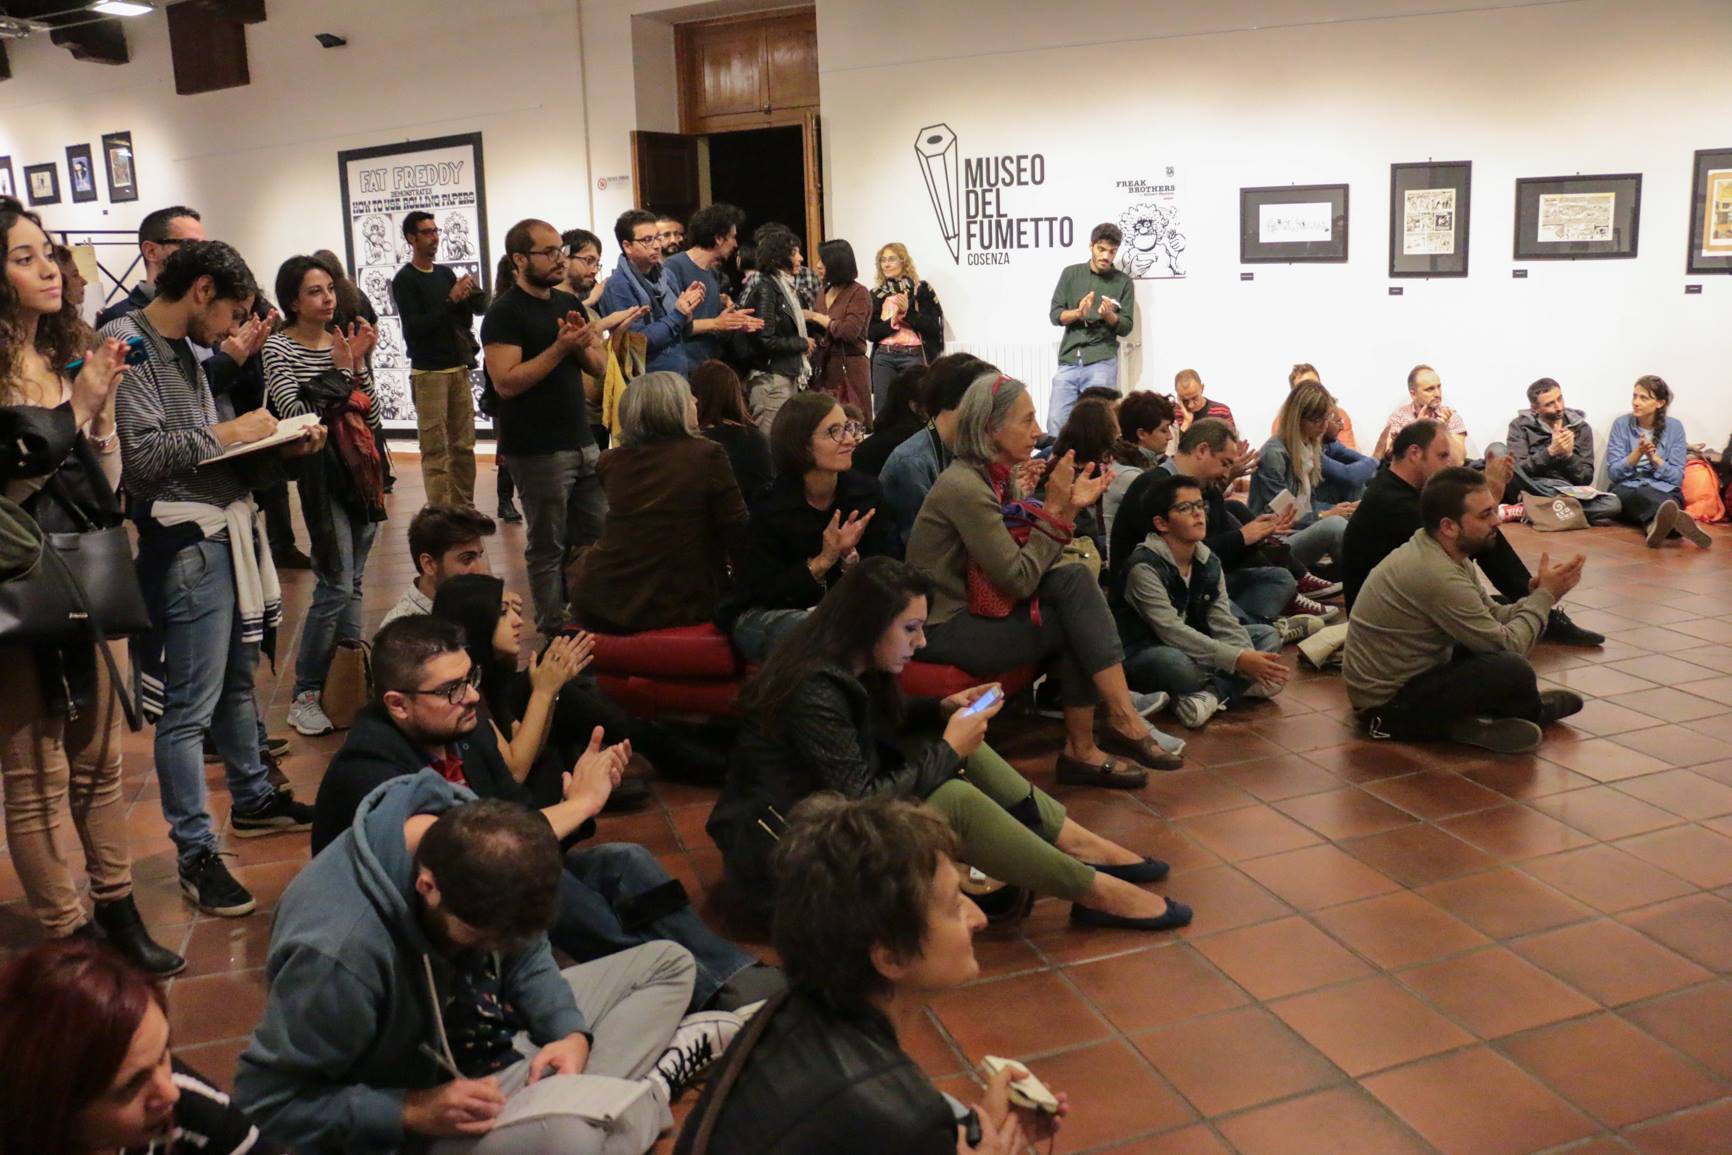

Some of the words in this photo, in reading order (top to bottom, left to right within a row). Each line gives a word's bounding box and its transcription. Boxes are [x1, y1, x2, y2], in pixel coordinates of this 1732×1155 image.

[360, 168, 387, 193] FAT
[393, 161, 464, 189] FREDDY
[964, 153, 1045, 189] MUSEO
[391, 188, 432, 198] DEMONSTRATES
[1116, 180, 1146, 188] FREAK
[1128, 185, 1175, 193] BROTHERS
[352, 200, 371, 214] HOW
[372, 199, 383, 212] TO
[384, 198, 401, 211] USE
[403, 194, 440, 210] ROLLING
[441, 191, 475, 206] PAPERS
[965, 188, 1008, 220] DEL
[966, 216, 1073, 250] FUMETTO
[967, 252, 1010, 266] COSENZA
